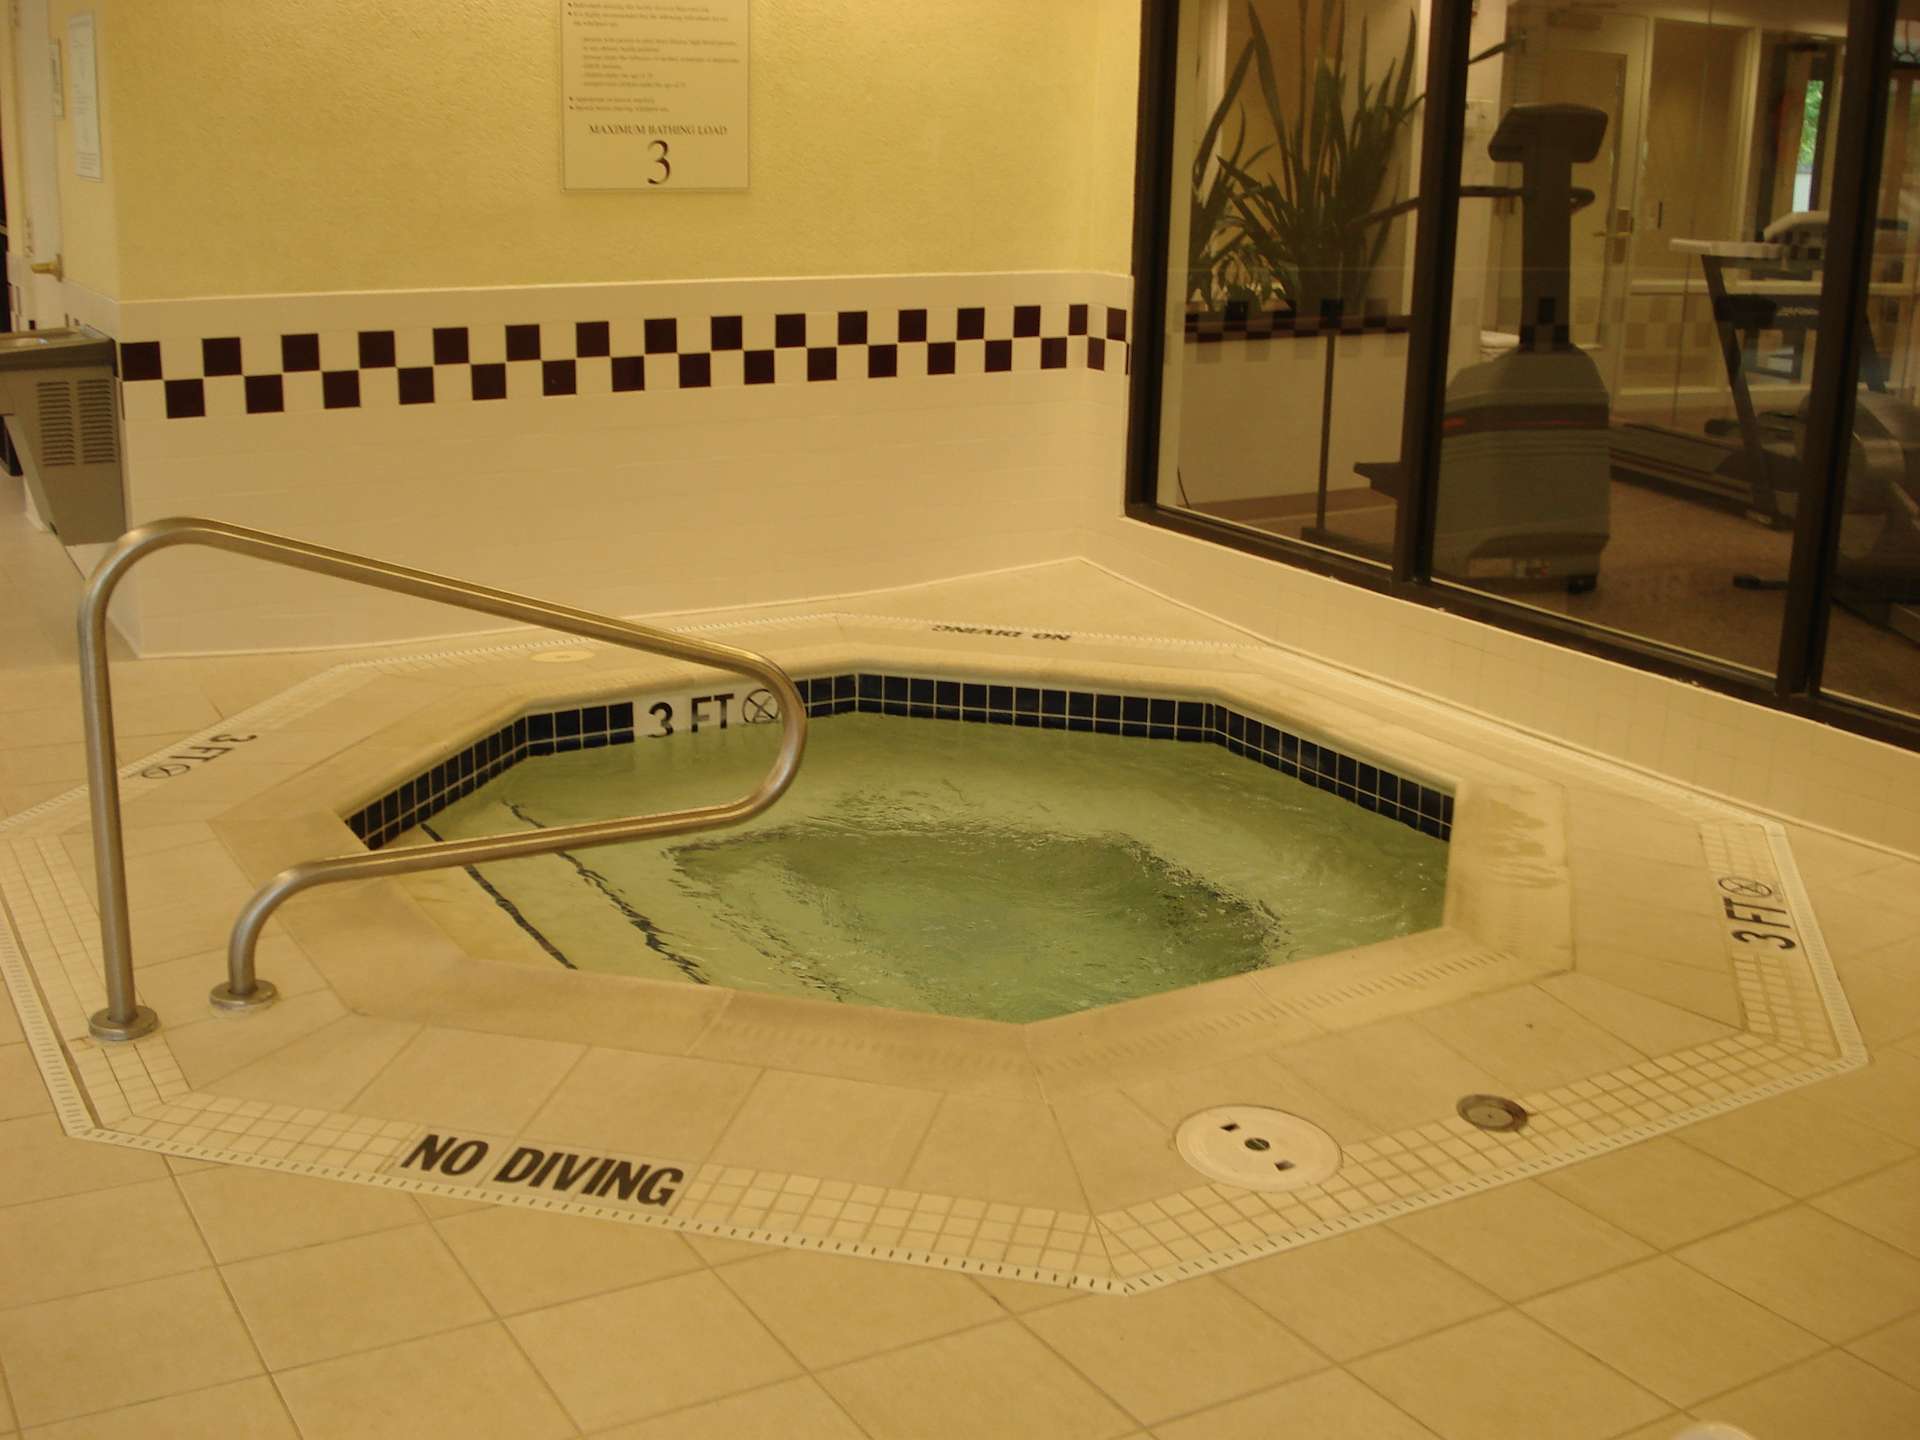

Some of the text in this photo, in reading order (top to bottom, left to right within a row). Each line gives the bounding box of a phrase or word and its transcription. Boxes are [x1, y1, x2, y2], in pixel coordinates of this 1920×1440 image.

[589, 124, 728, 136] MAXIMUM BATHING LOAD
[647, 139, 671, 185] 3
[648, 693, 734, 738] 3 FT
[1723, 896, 1796, 950] 3 FT
[400, 1134, 684, 1207] NO DIVING
